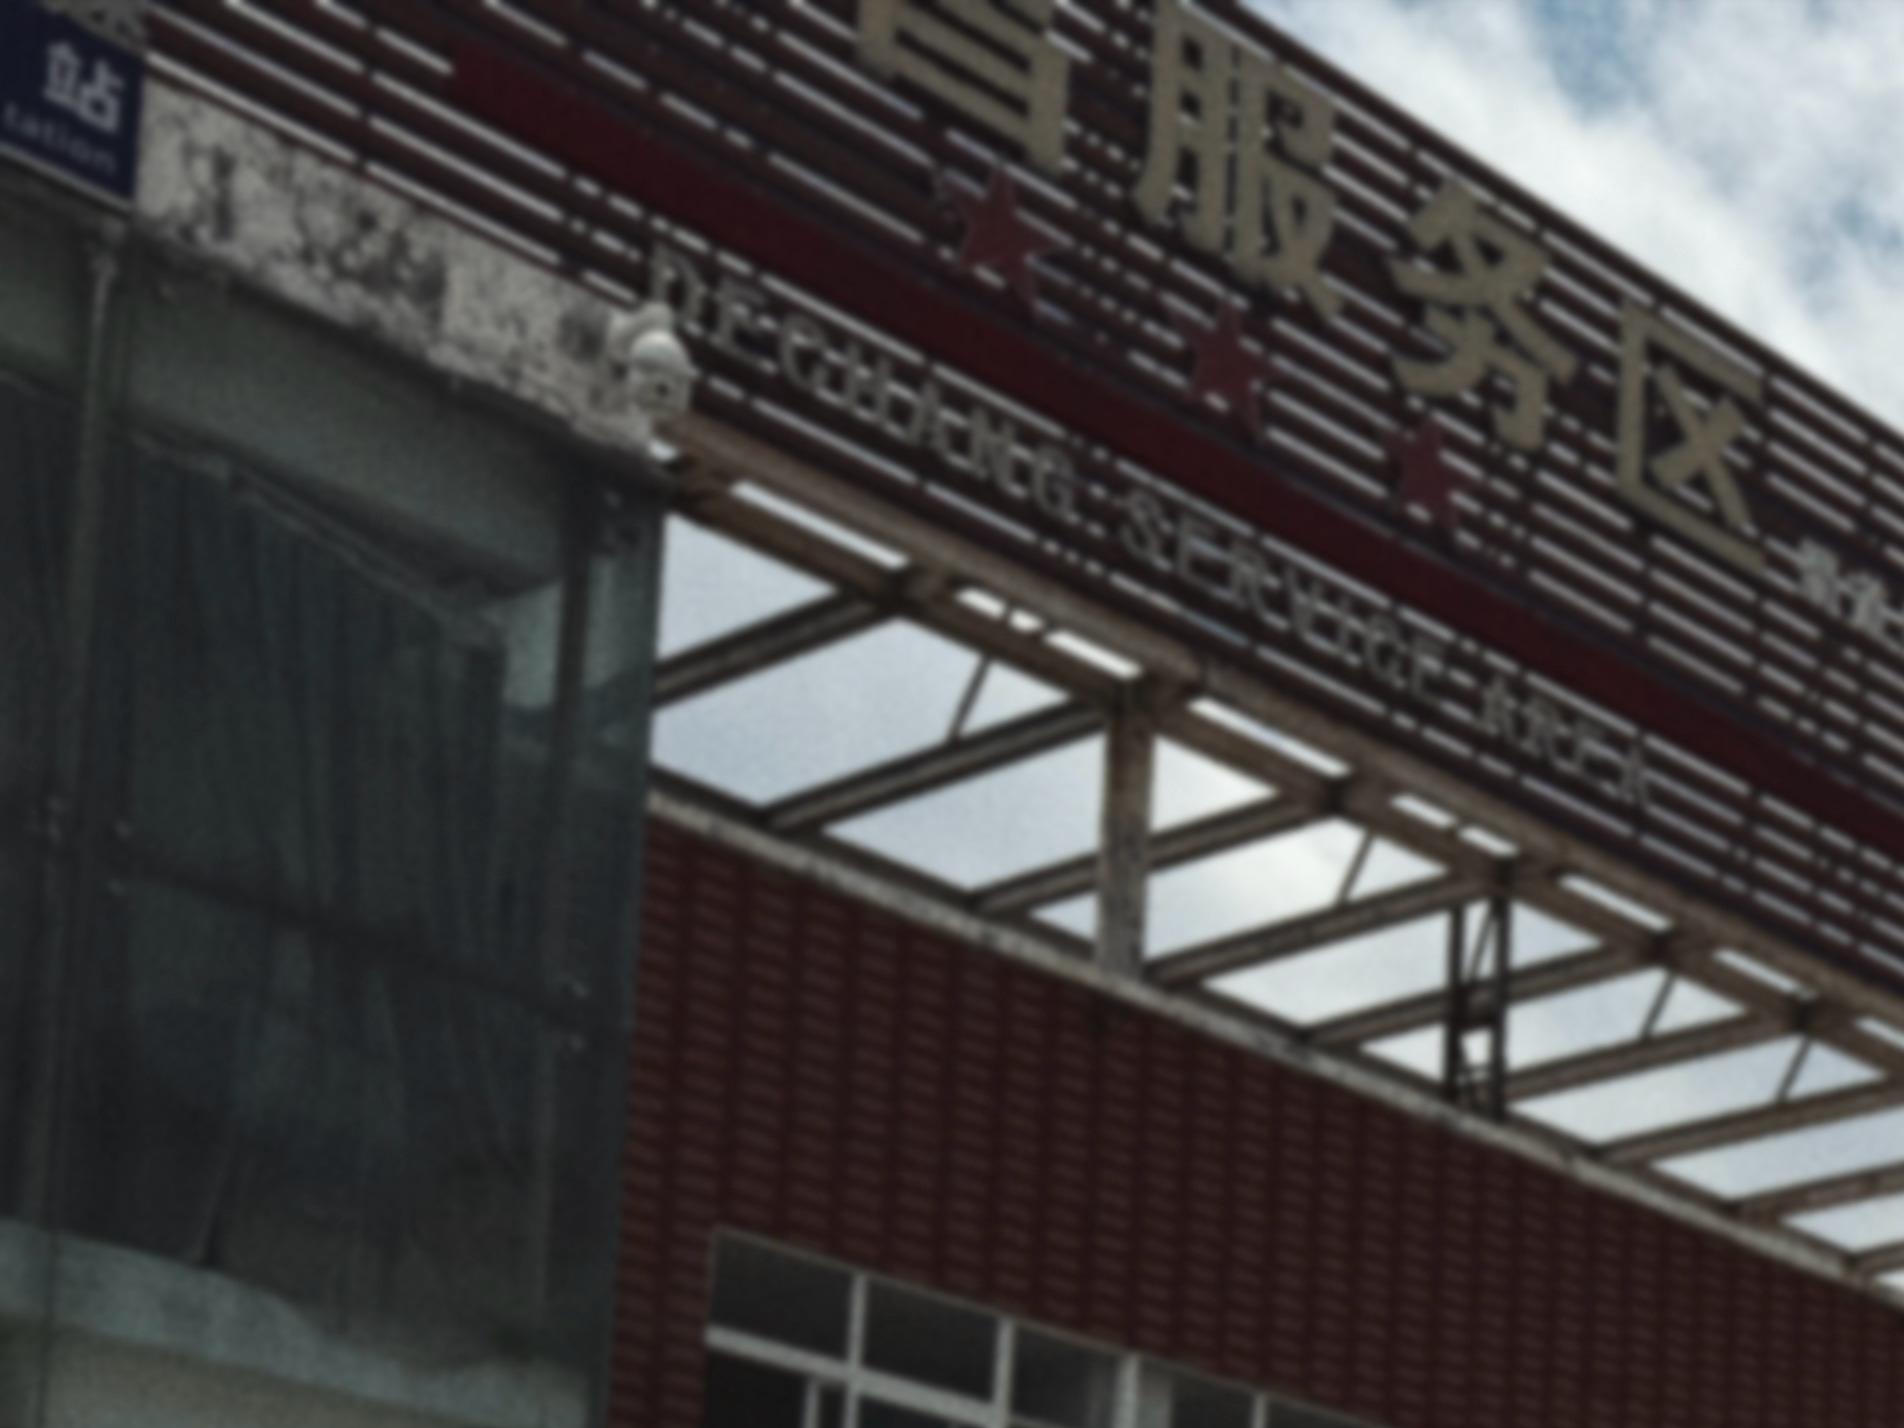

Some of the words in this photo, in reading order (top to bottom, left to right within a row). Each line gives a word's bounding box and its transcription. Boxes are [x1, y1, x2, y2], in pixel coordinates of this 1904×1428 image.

[42, 42, 125, 133] 站
[1118, 488, 1446, 698] SERVICE
[1478, 674, 1650, 806] AREA
